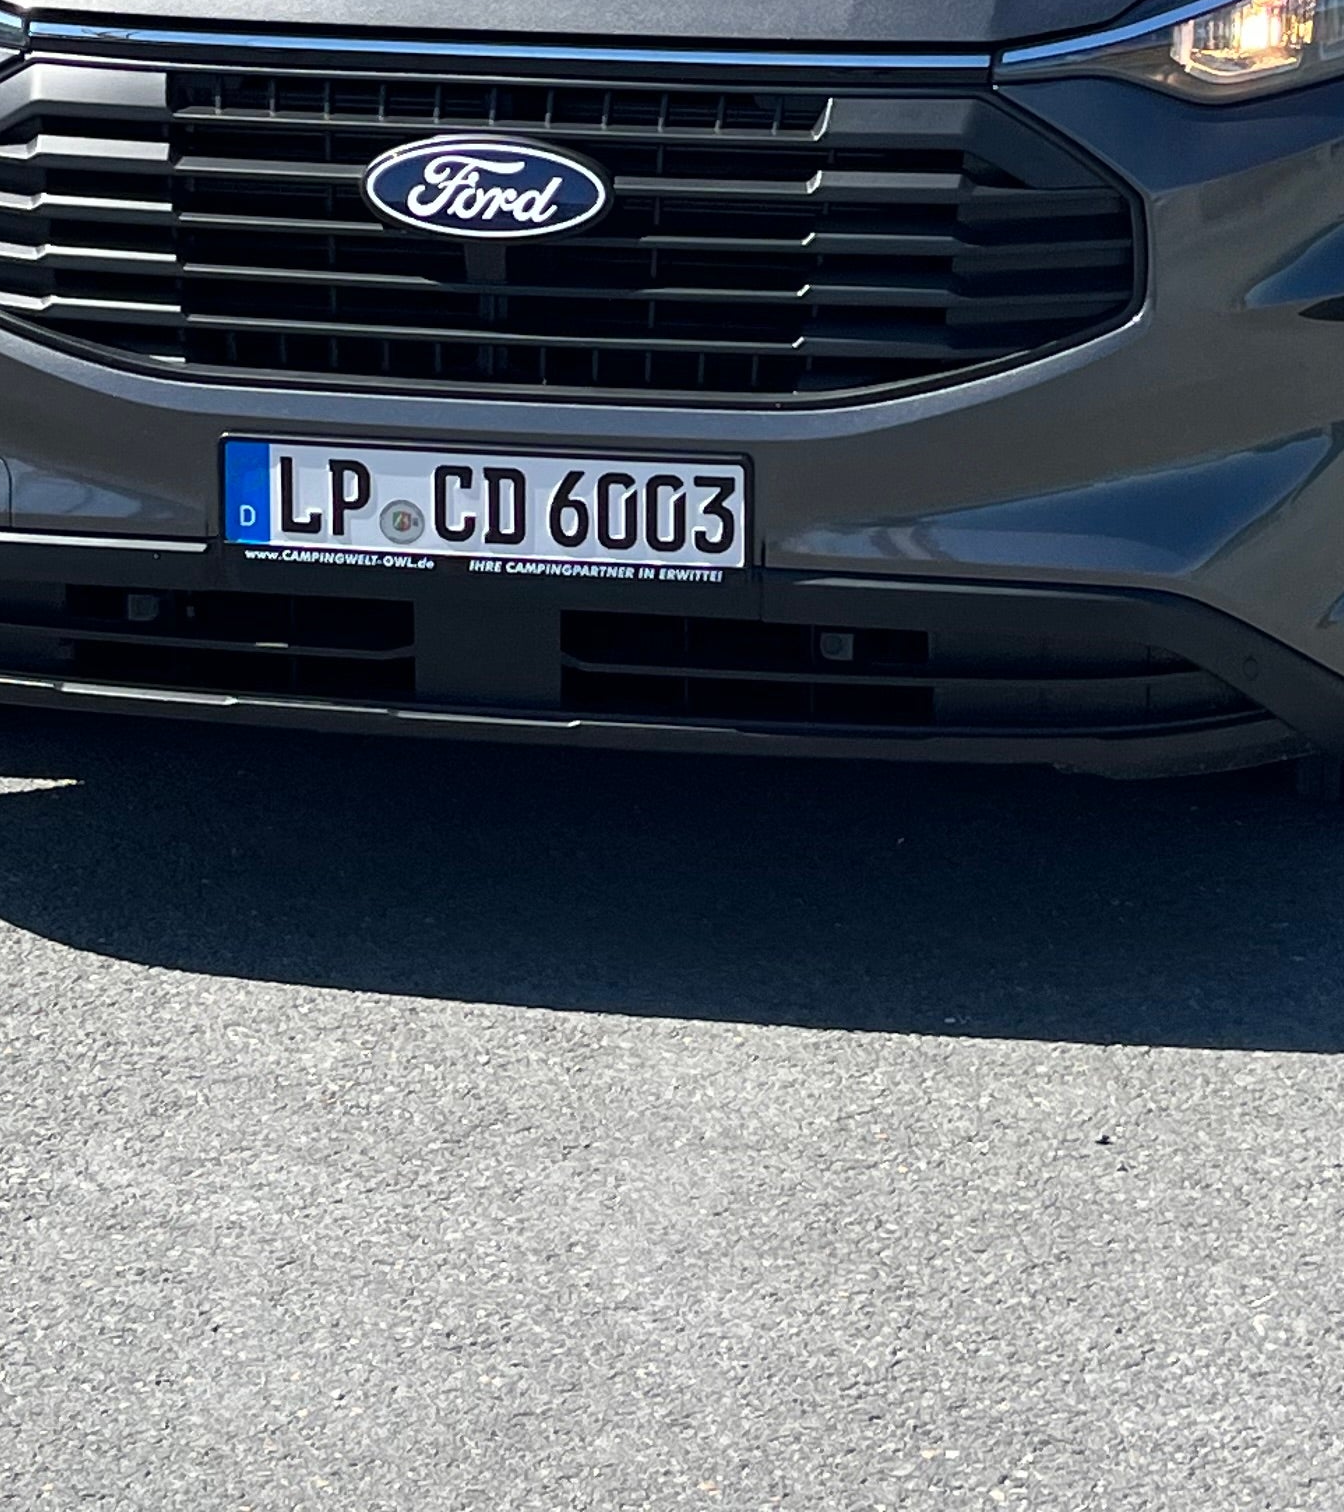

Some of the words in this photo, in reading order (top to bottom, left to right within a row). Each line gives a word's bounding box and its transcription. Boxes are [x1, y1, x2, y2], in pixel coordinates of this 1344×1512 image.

[407, 154, 563, 223] Ford
[239, 504, 257, 527] D
[279, 455, 372, 537] LP
[433, 464, 527, 546] CD
[548, 469, 737, 554] 6003
[468, 559, 503, 573] IHRE
[505, 561, 635, 580] CAMPINGPARTNER
[638, 567, 655, 580] IN
